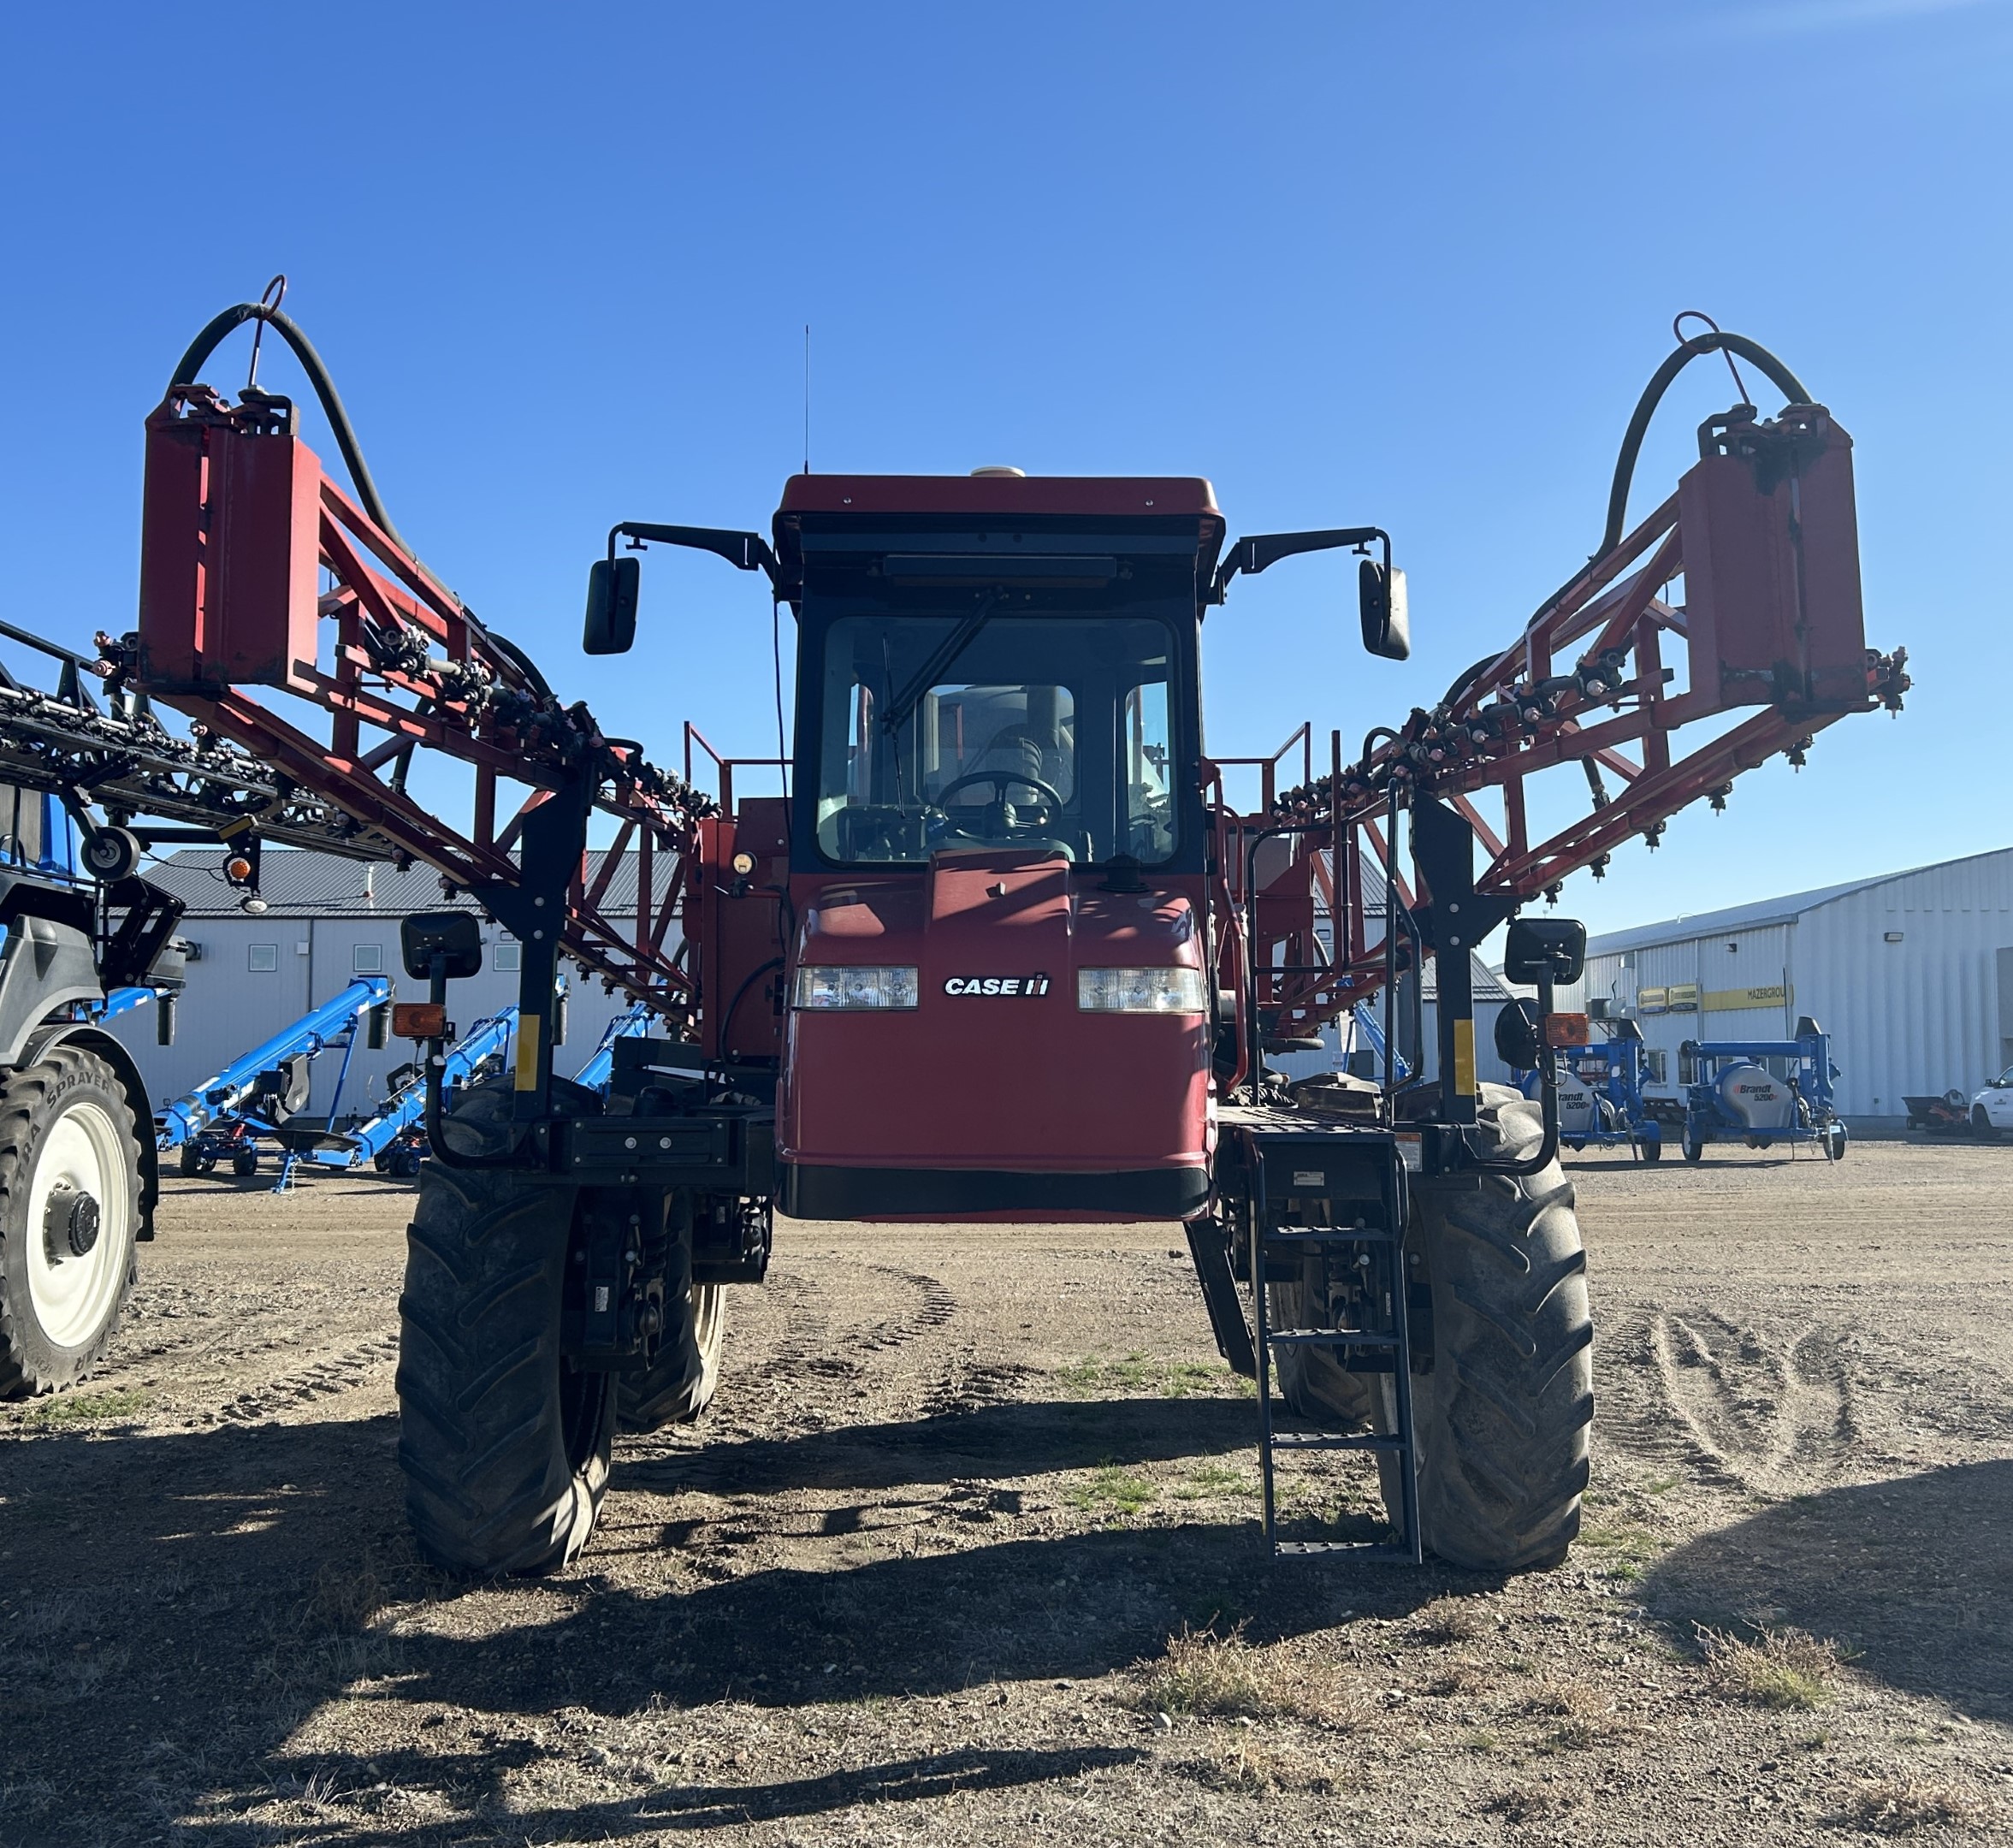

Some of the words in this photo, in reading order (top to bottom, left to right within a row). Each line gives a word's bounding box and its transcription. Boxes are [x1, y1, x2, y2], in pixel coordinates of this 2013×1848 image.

[945, 978, 1020, 995] CASE
[1747, 986, 1785, 1000] MAZERGROU
[46, 1071, 110, 1111] SPRAYER
[1740, 1084, 1772, 1093] Brandt
[1558, 1093, 1584, 1101] randt
